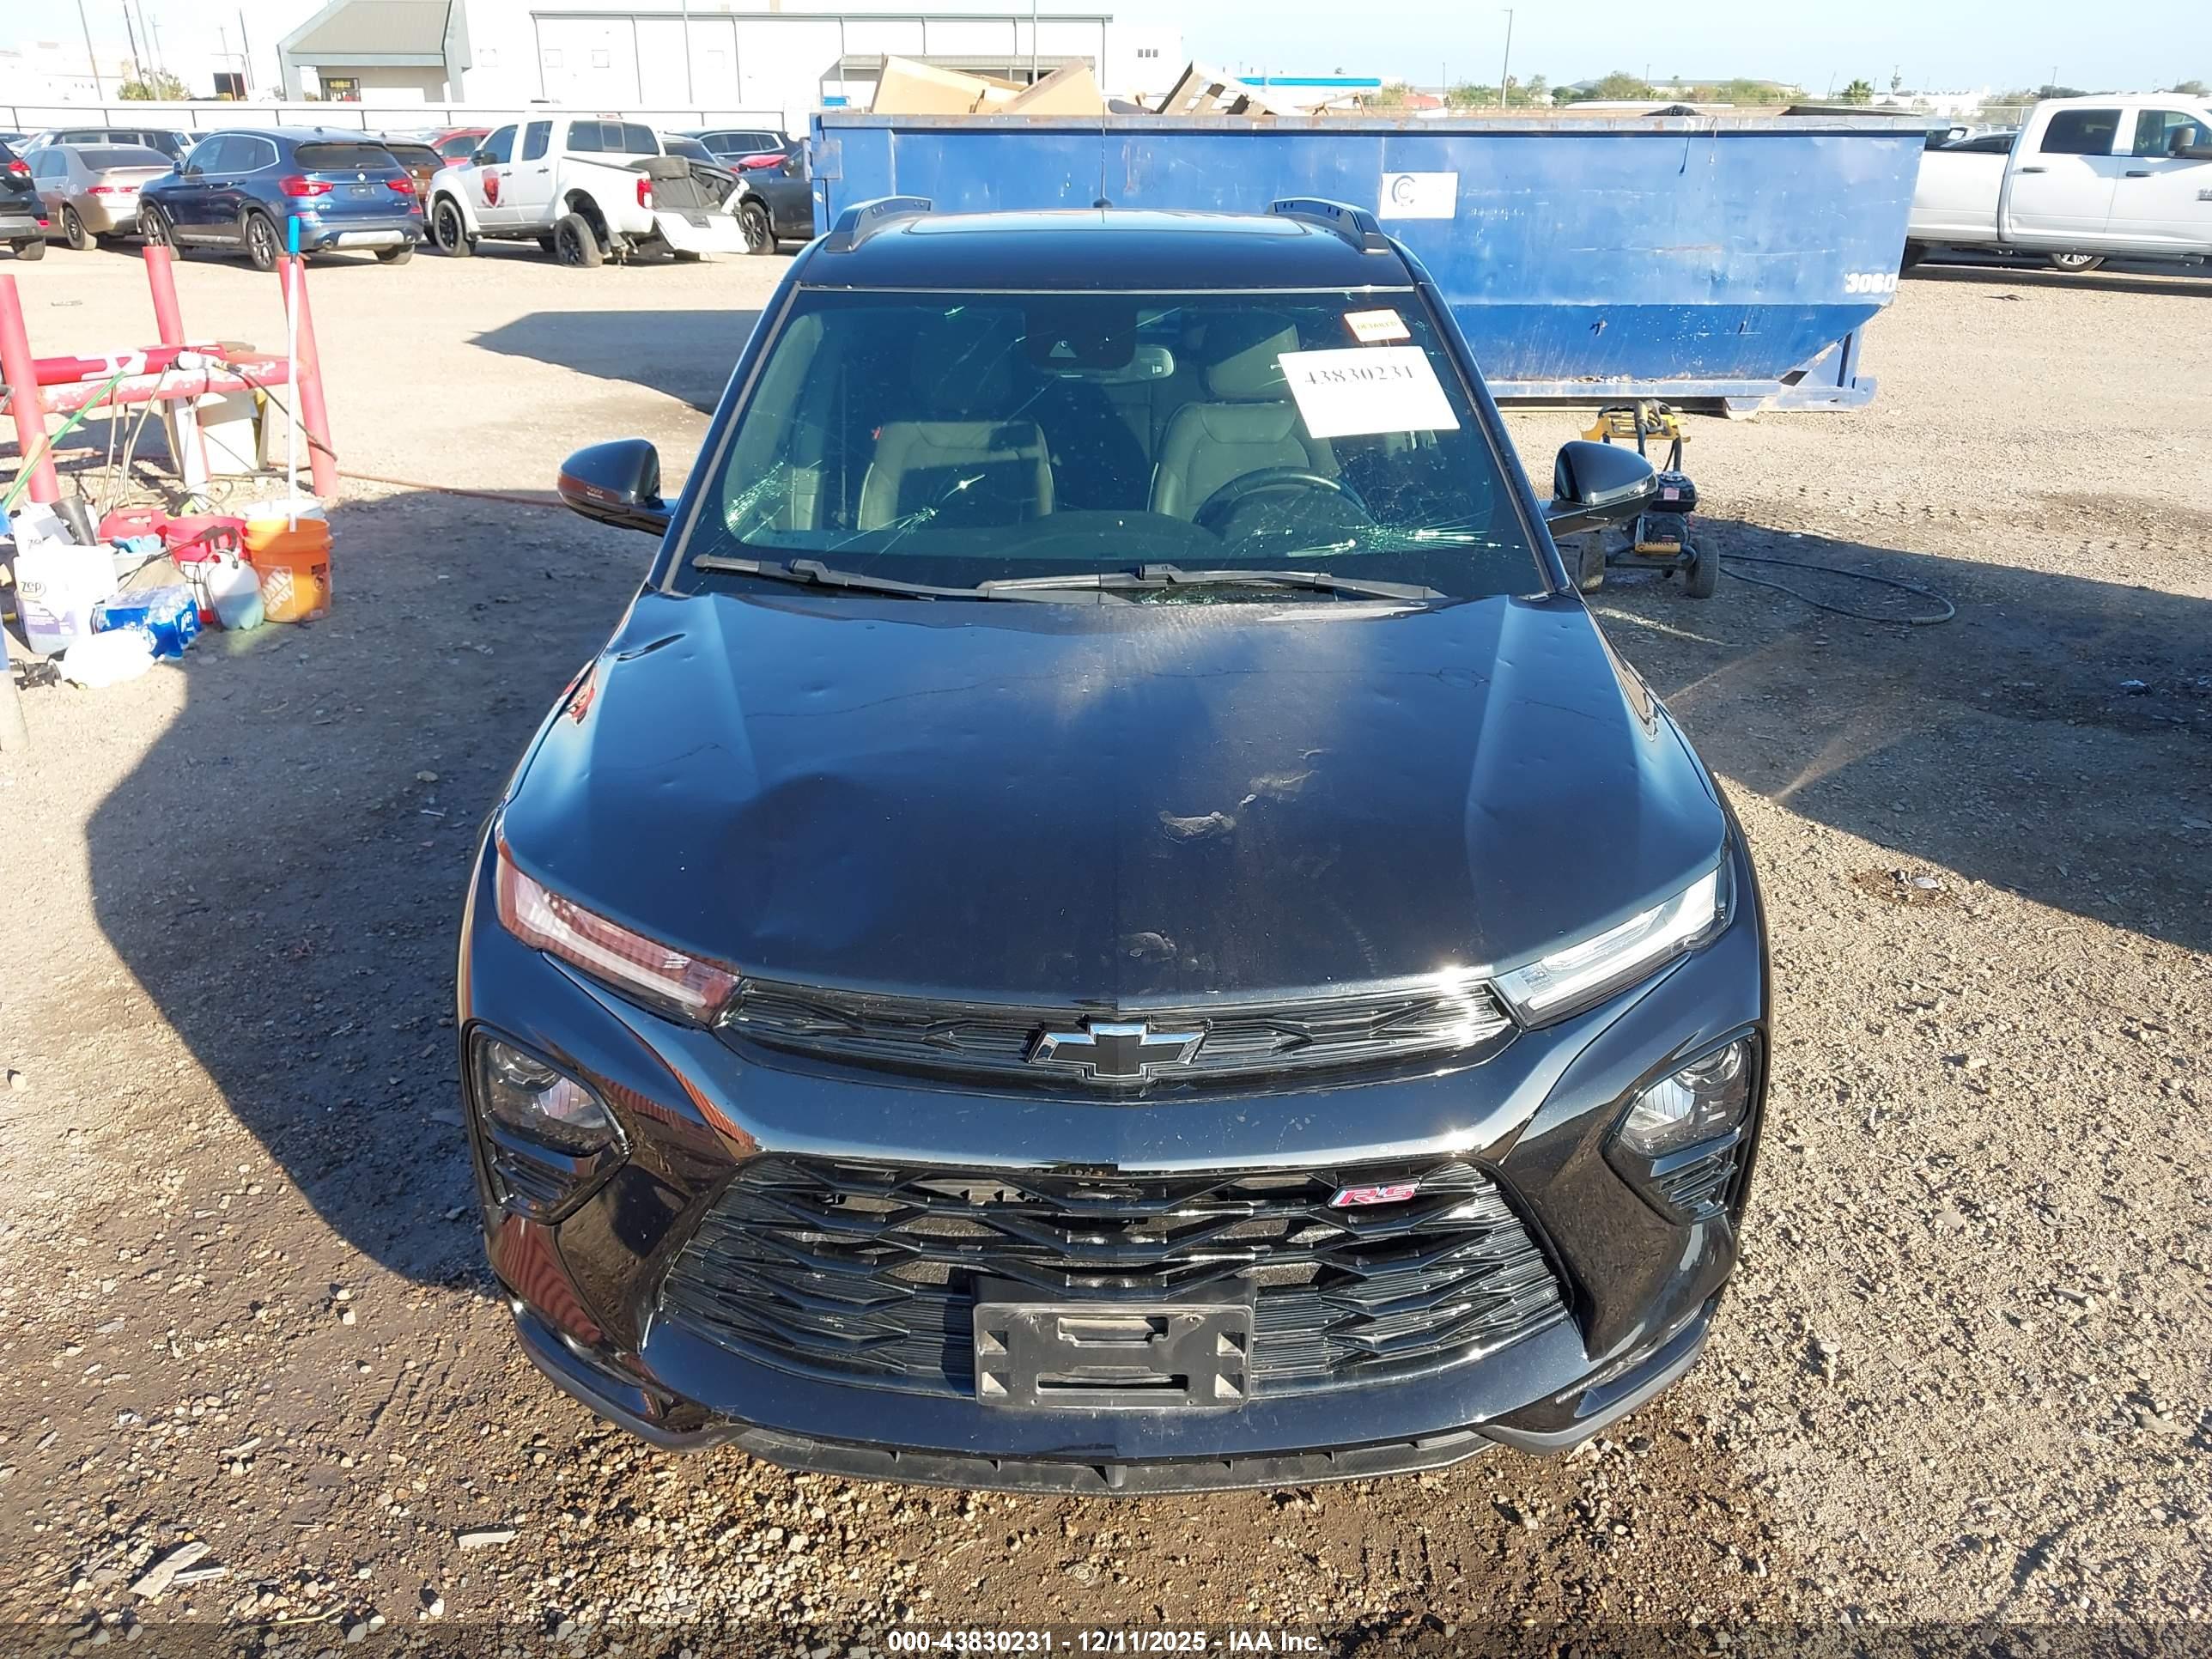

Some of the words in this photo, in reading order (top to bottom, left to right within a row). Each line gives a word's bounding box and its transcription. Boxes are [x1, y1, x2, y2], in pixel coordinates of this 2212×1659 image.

[1844, 272, 1897, 293] 3060
[1305, 365, 1413, 385] 43830231
[1328, 1184, 1419, 1208] RS
